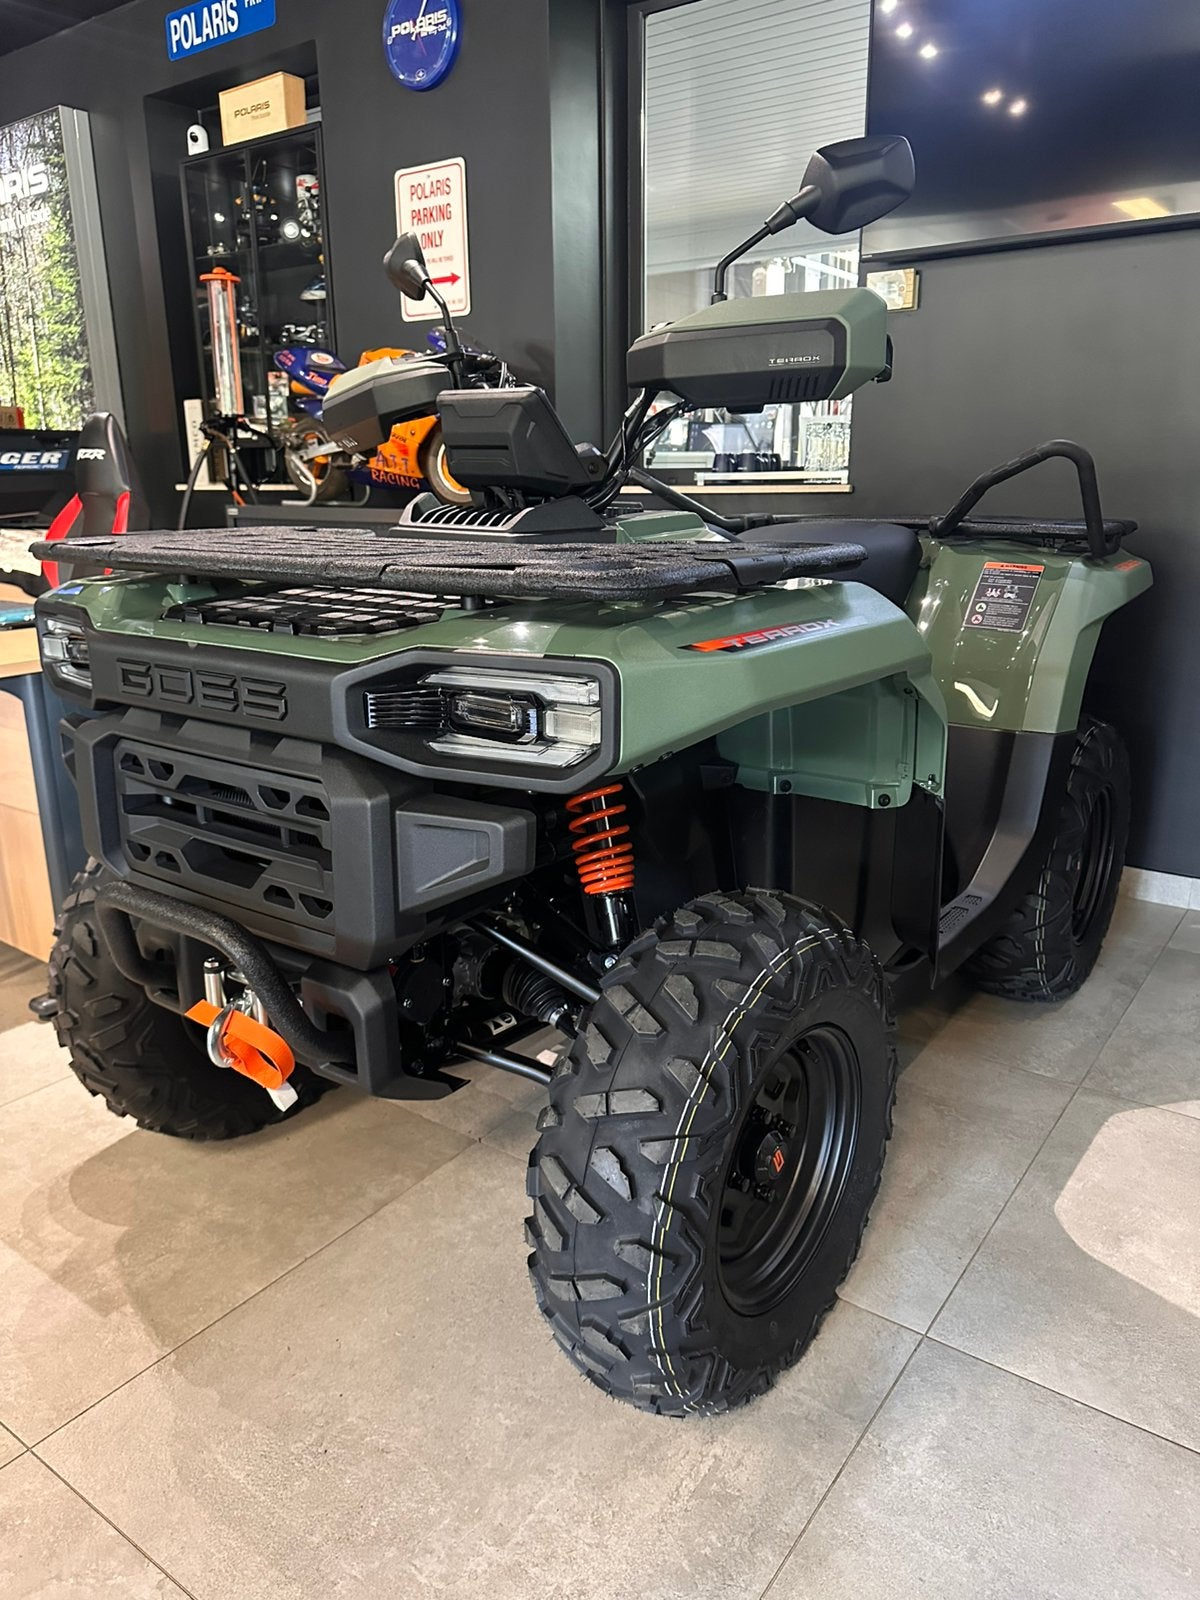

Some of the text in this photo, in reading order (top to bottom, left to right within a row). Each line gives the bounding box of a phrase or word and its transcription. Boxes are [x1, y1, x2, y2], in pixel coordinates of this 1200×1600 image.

[170, 0, 239, 53] POLARIS
[391, 9, 448, 38] POLARIS
[234, 100, 271, 118] POLARIS
[0, 162, 49, 206] RIS
[410, 177, 452, 202] POLARIS
[411, 203, 452, 227] PARKING
[420, 230, 444, 250] ONLY
[768, 356, 820, 364] TERROX
[371, 468, 420, 489] RACING
[722, 618, 841, 648] TERROX
[116, 657, 288, 721] GOES
